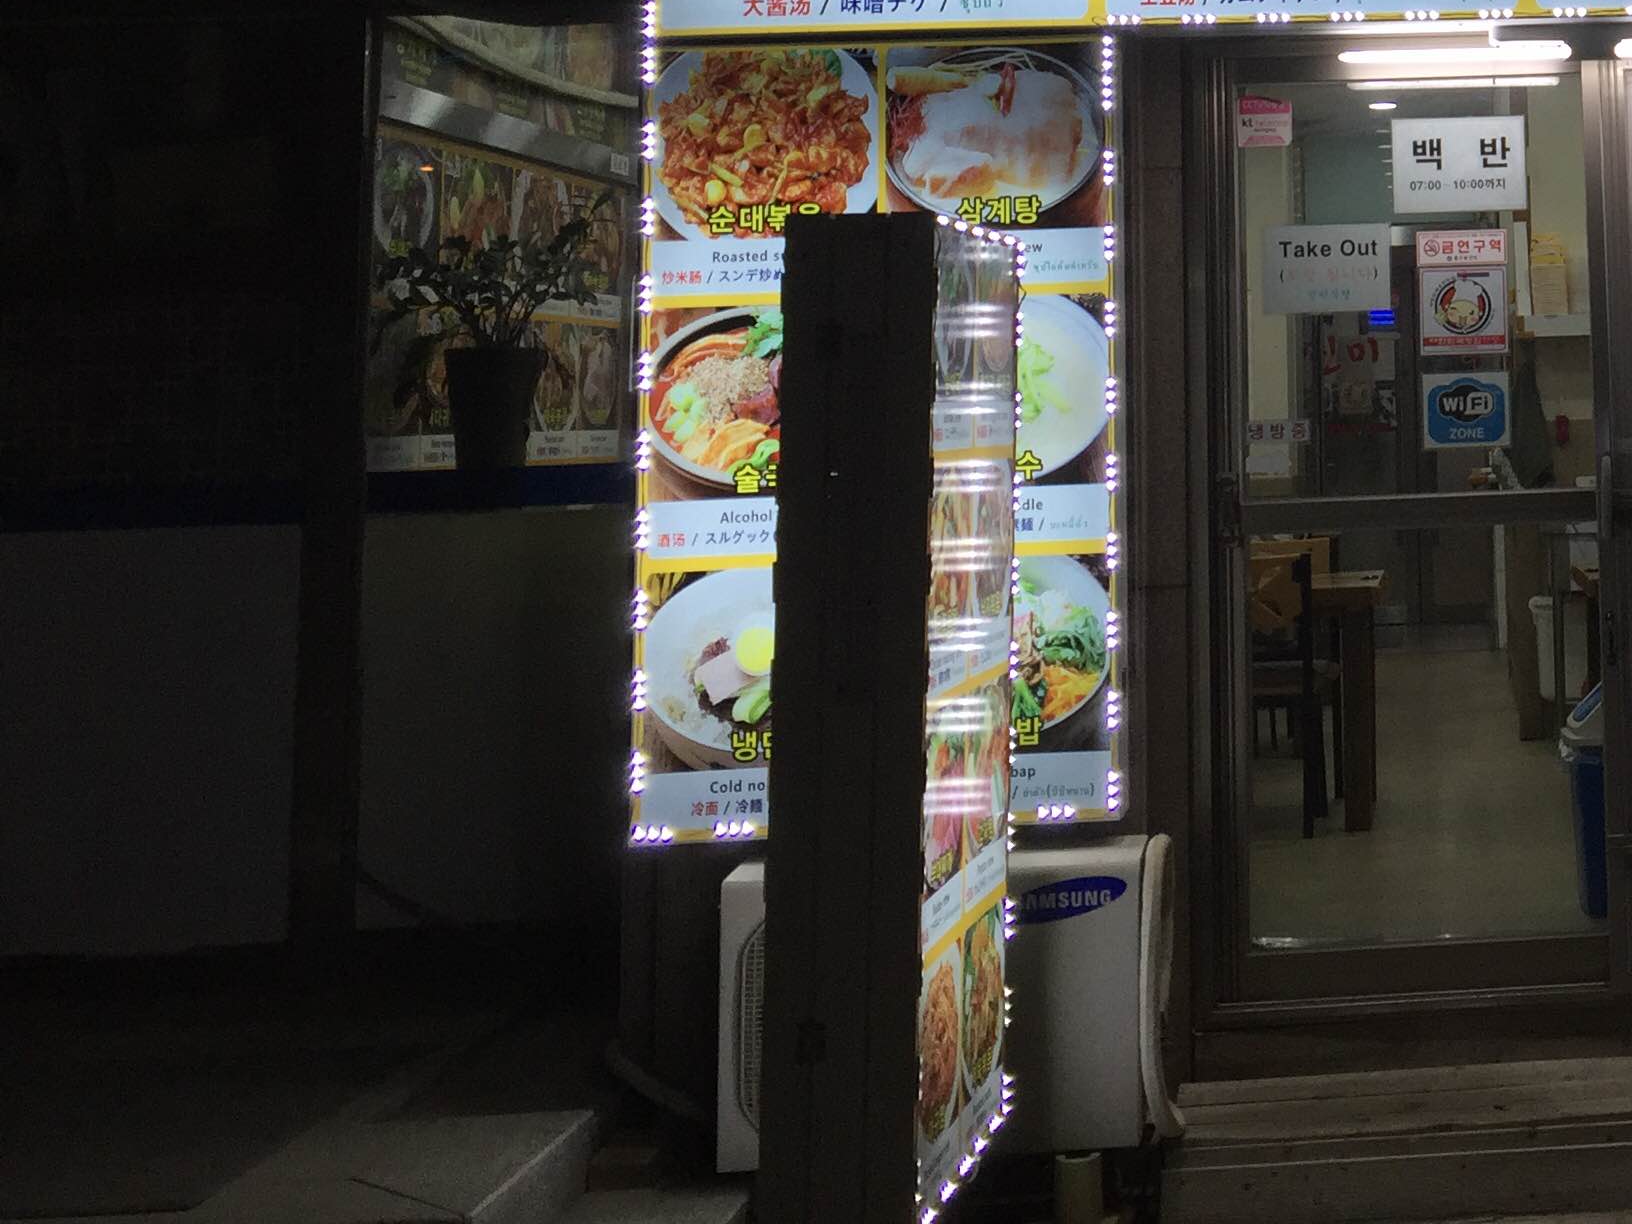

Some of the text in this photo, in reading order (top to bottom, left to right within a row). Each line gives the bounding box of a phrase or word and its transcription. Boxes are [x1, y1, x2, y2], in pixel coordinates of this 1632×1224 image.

[1412, 137, 1511, 170] 백 반
[1410, 180, 1441, 191] 07:00
[957, 194, 1042, 225] 삼계탕
[713, 250, 768, 263] Roasted
[1279, 240, 1378, 259] Take Out
[1449, 427, 1486, 440] ZONE
[720, 509, 772, 524] Alcohol
[710, 779, 742, 794] Cold
[1025, 889, 1112, 911] AMSUNG
